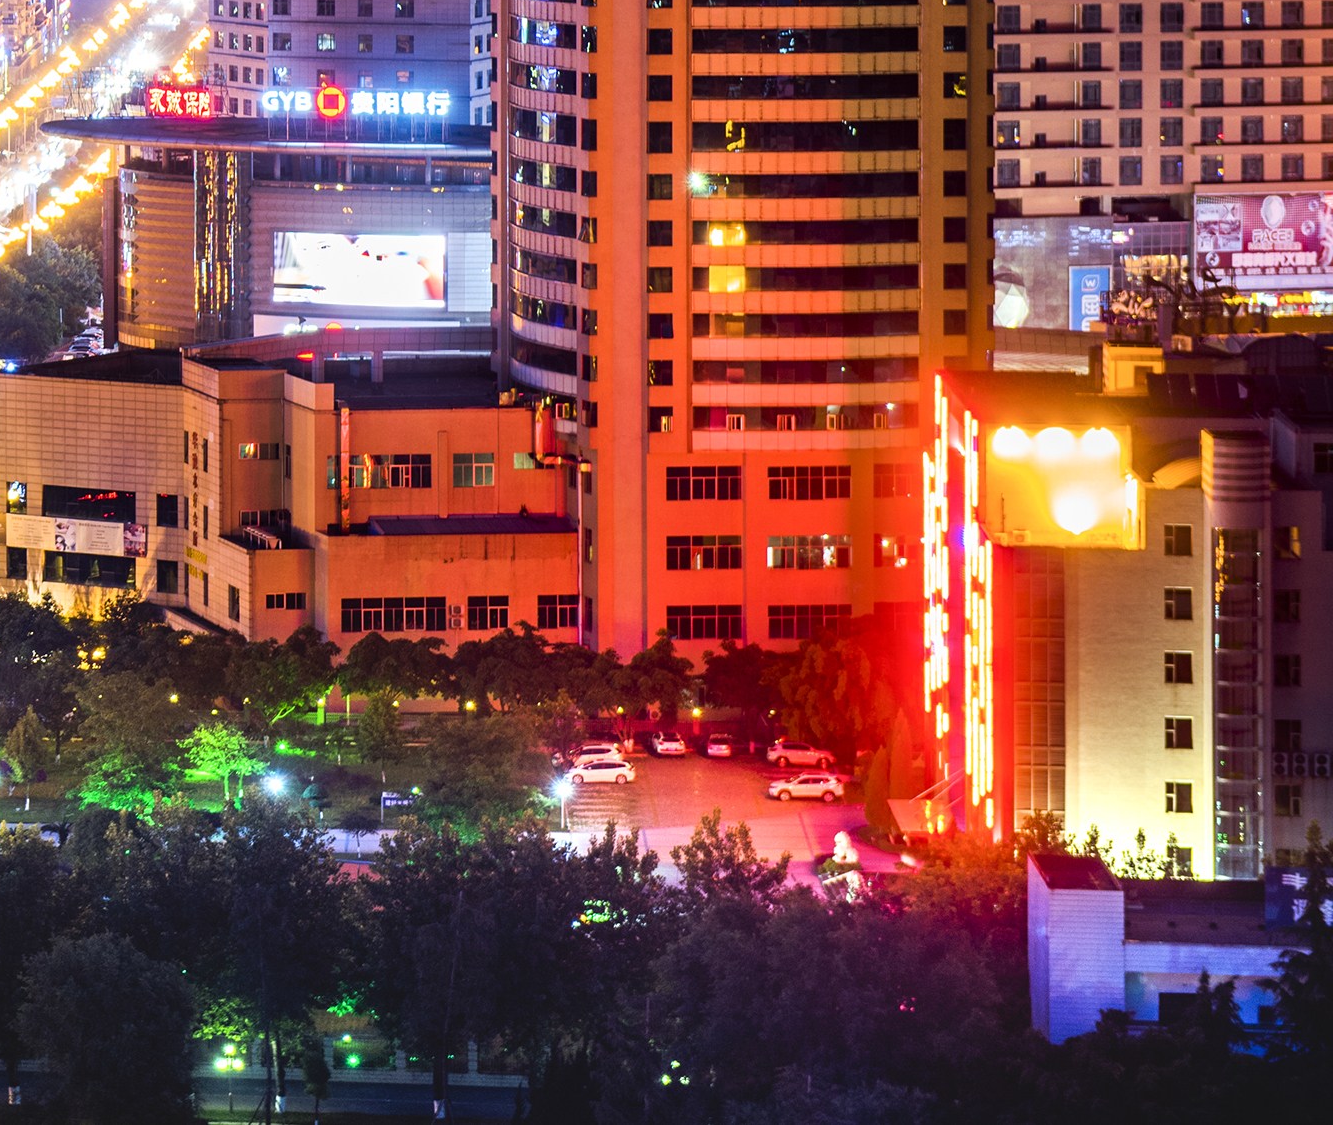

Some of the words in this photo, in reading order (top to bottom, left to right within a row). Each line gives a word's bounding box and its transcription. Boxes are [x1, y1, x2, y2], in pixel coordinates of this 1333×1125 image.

[261, 91, 312, 112] GYB
[350, 90, 451, 115] 贵阳银行
